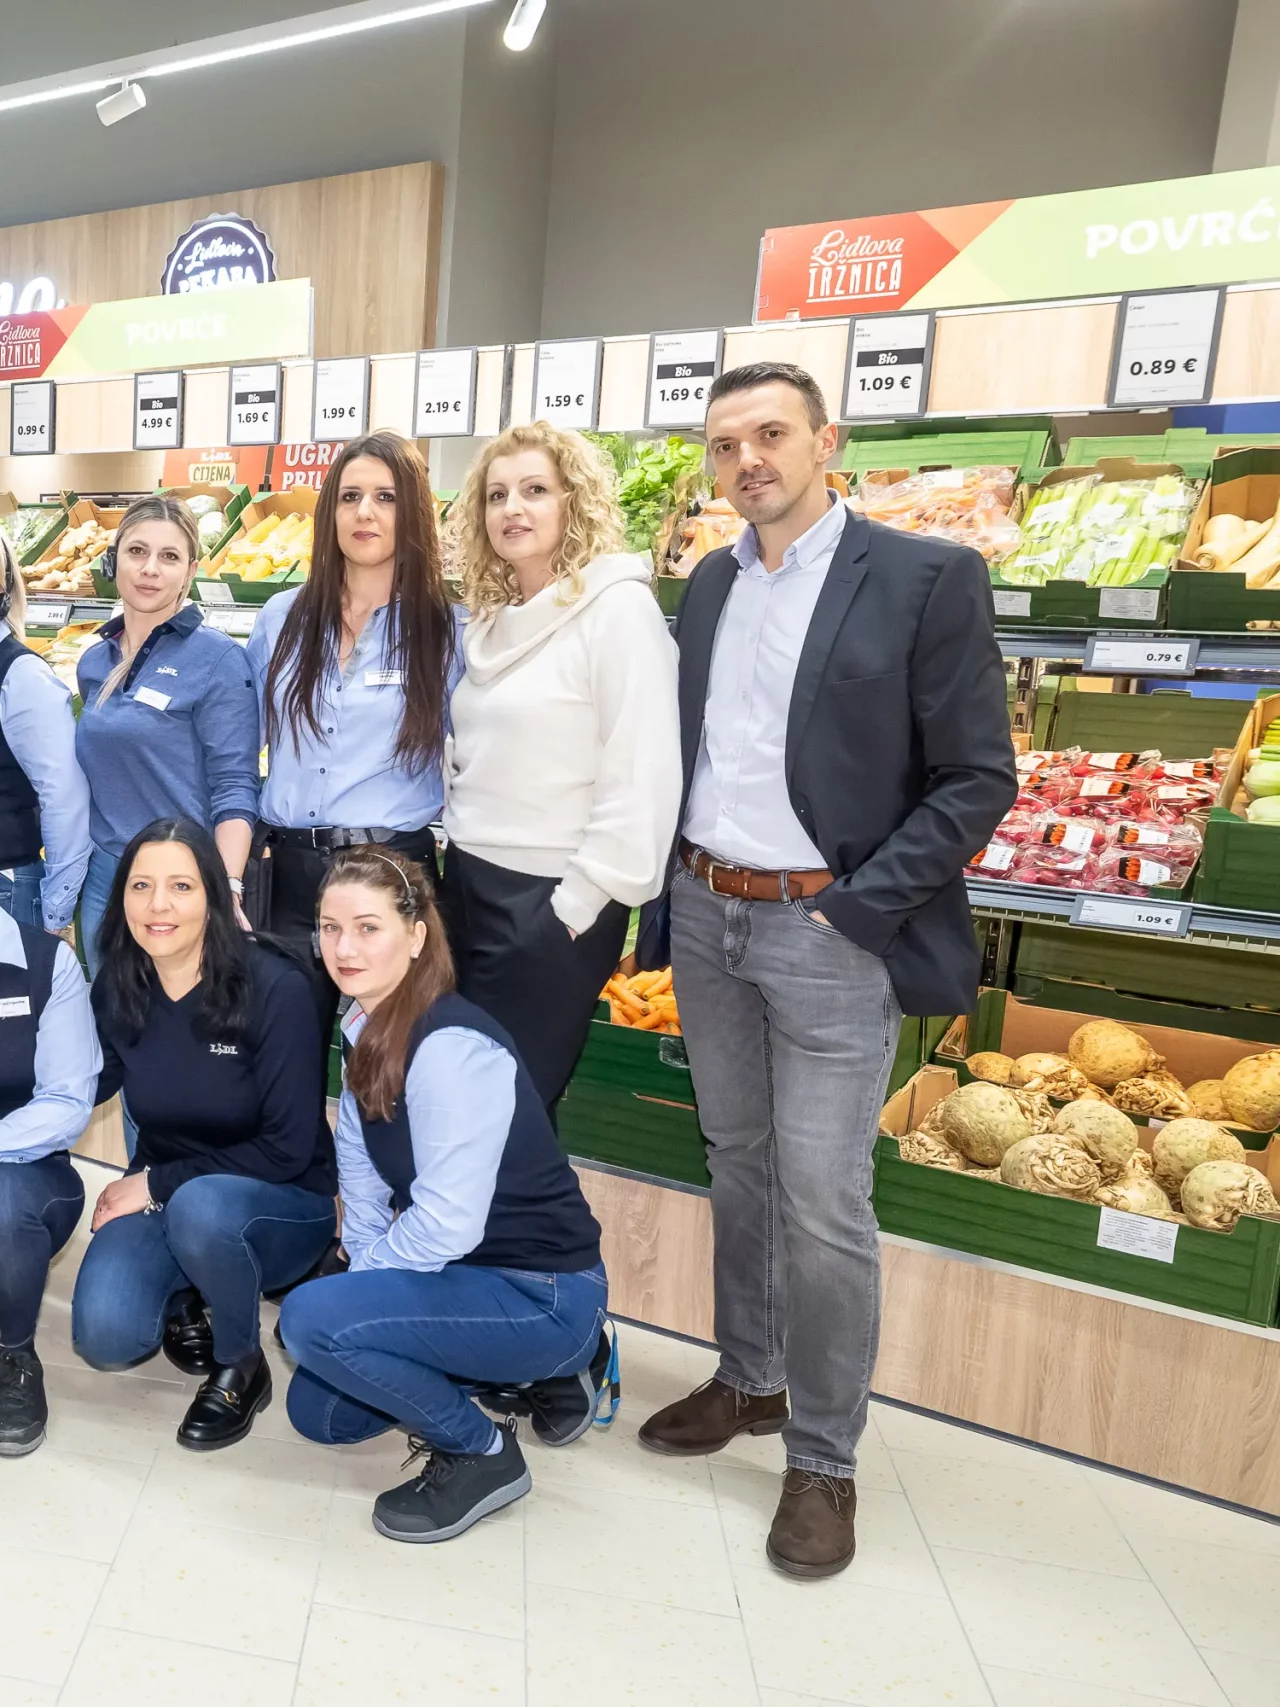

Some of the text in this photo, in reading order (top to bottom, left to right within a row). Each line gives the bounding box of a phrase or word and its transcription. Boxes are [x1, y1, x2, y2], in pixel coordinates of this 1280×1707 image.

[1085, 197, 1280, 259] POVRĆ
[809, 229, 905, 267] Lidlova
[184, 236, 246, 274] Lidlova
[808, 259, 903, 298] TRŽNICA
[878, 352, 898, 365] Bio
[674, 365, 692, 378] Bio
[1130, 358, 1197, 376] 0.89 €
[859, 375, 911, 391] 1.09 €
[247, 394, 260, 403] Bio
[544, 394, 584, 408] 1.59 €
[659, 387, 704, 402] 1.69 €
[151, 400, 163, 409] Bio
[425, 401, 461, 414] 2.19 €
[237, 411, 269, 423] 1.69 €
[322, 407, 356, 419] 1.99 €
[141, 417, 172, 429] 4.99 €
[17, 424, 45, 436] 0.99 €
[200, 448, 232, 463] LIDL
[193, 466, 231, 481] CIJENA
[282, 470, 322, 491] PRIL
[1146, 653, 1182, 662] 0.79 €
[1137, 914, 1173, 925] 1.09 €
[209, 1043, 238, 1055] LIDL
